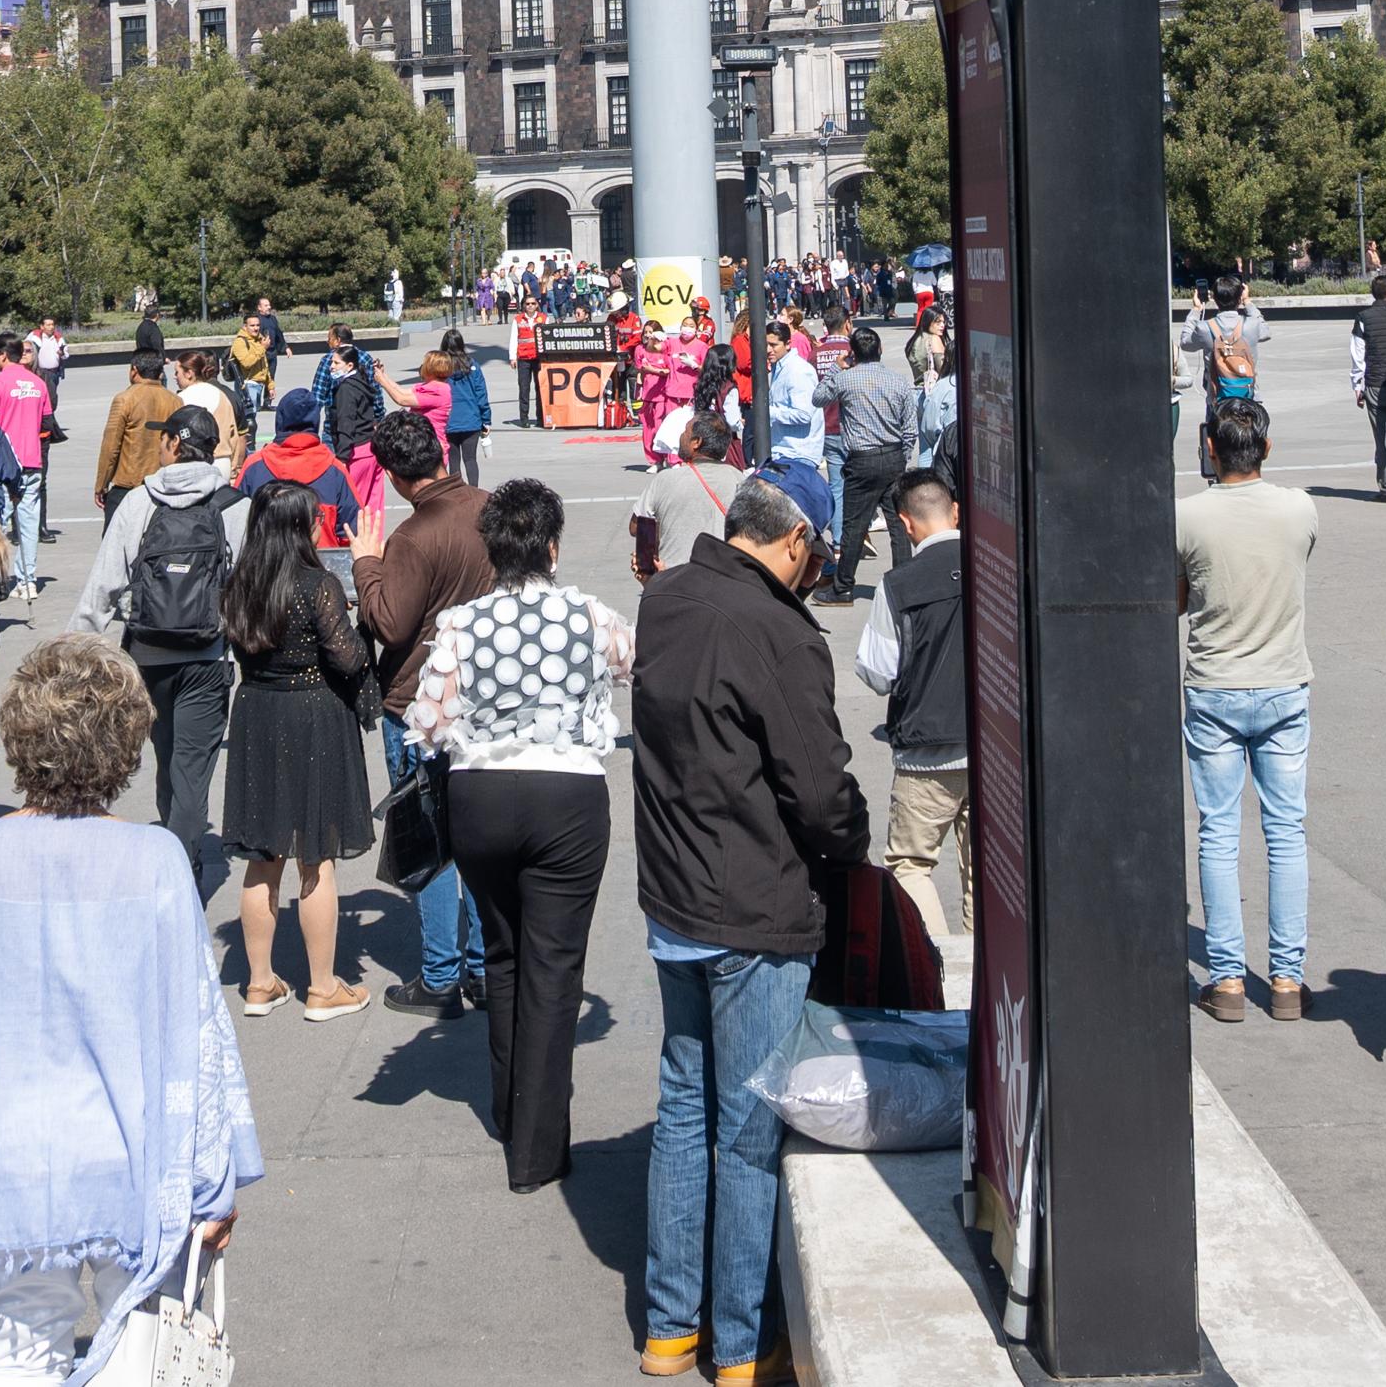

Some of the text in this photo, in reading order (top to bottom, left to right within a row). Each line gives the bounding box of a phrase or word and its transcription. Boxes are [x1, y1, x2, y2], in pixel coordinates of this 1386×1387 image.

[643, 284, 693, 306] ACV
[553, 327, 594, 338] COMANDO
[544, 340, 605, 350] DE INCIDENTES
[547, 365, 602, 405] PC
